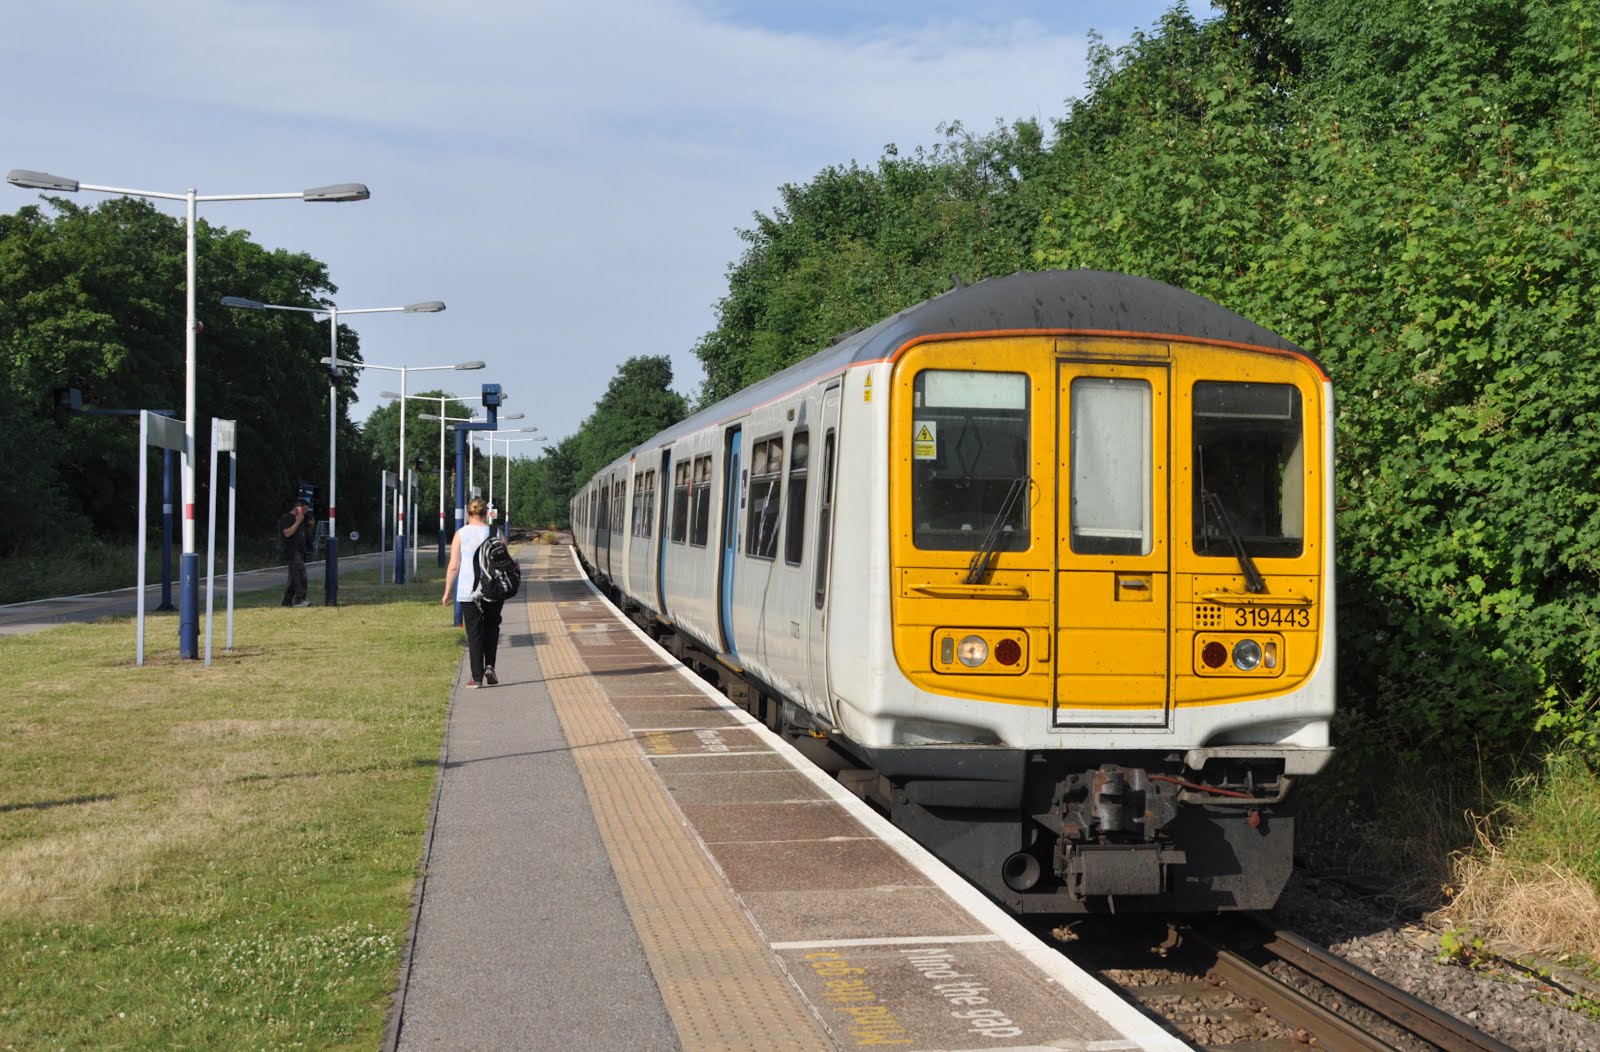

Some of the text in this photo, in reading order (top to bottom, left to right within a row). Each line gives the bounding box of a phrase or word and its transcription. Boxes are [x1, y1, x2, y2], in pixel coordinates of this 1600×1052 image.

[1235, 608, 1309, 627] 319443
[822, 979, 877, 1003] the
[900, 949, 1023, 1037] Mind the gap
[833, 1005, 914, 1045] Mind
